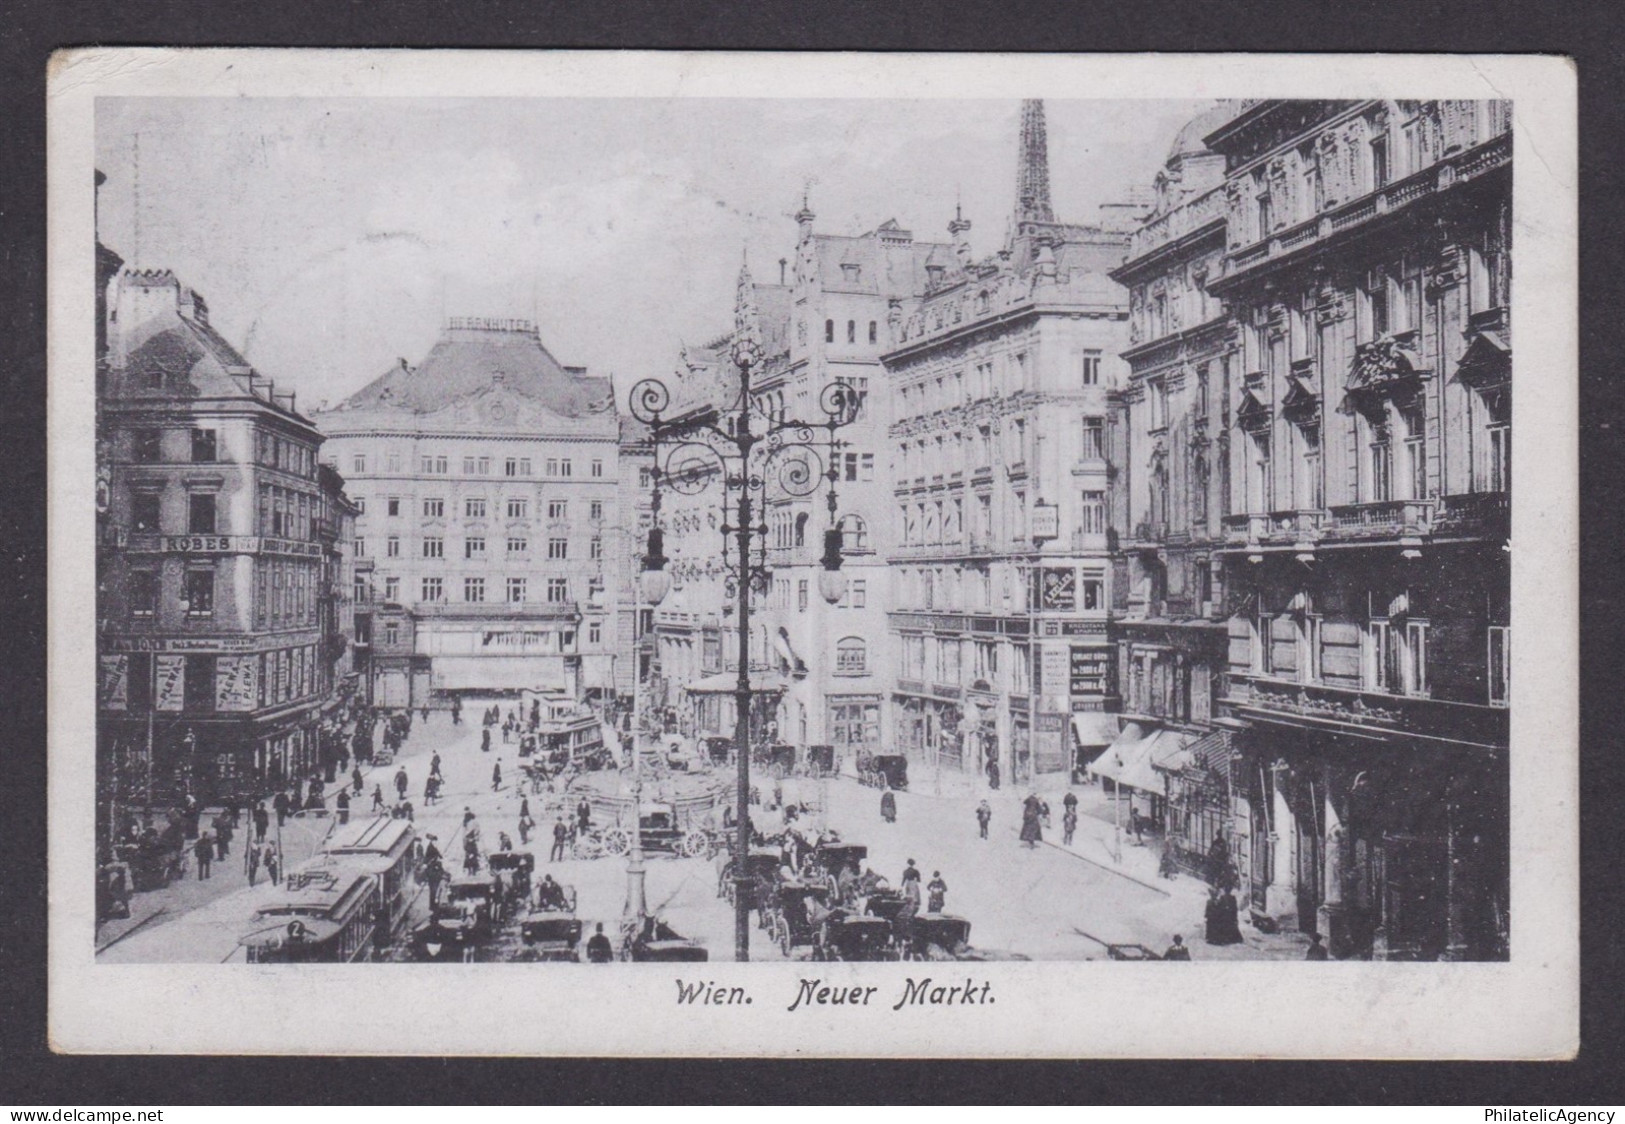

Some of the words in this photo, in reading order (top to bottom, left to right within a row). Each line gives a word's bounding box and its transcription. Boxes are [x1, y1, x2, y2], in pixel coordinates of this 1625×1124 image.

[167, 537, 229, 550] ROBES
[160, 667, 181, 701] PLEWA
[219, 666, 239, 701] PLEWA
[243, 664, 252, 700] PLEWA
